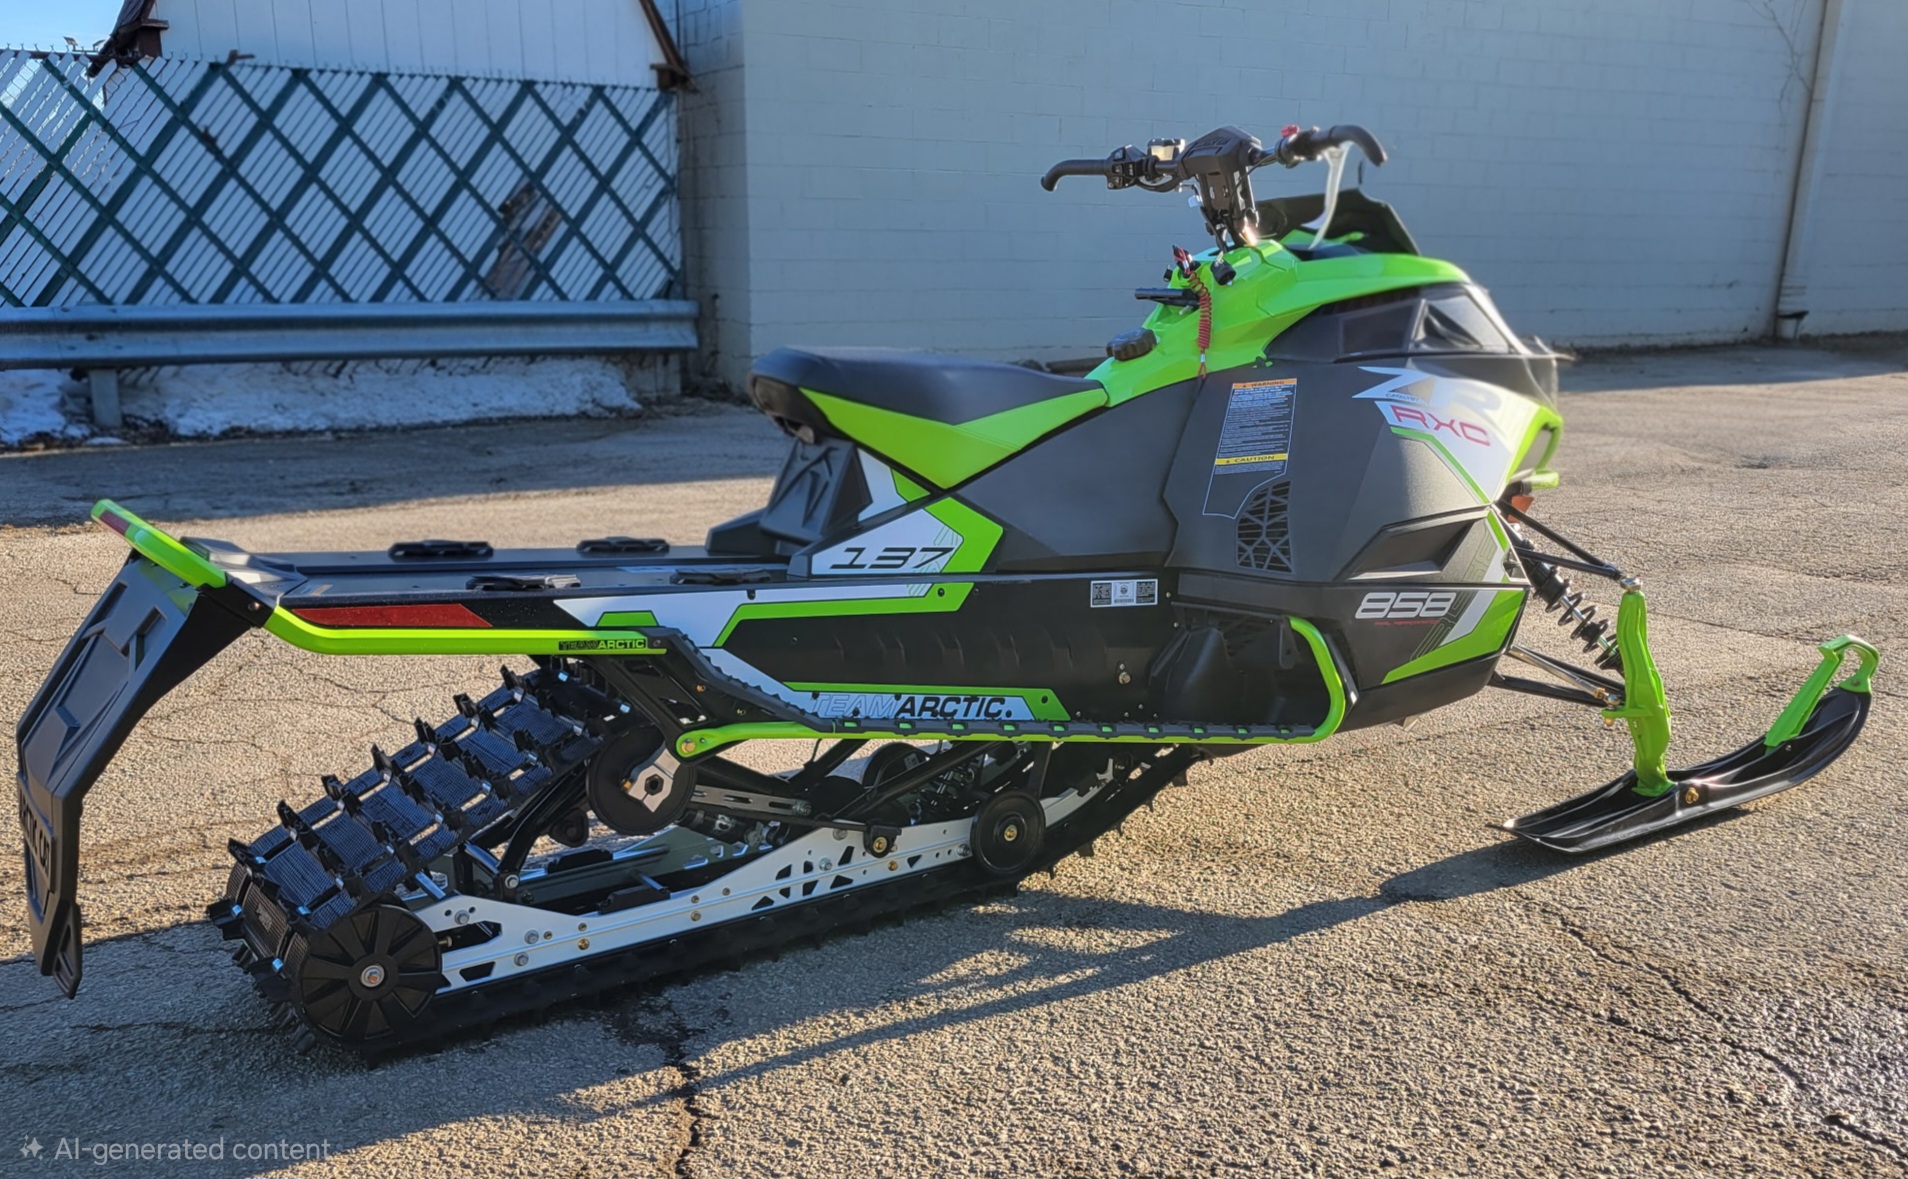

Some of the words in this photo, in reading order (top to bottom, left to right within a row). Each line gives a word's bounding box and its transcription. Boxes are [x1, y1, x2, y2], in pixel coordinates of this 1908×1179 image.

[1251, 380, 1285, 388] WARNING
[1389, 404, 1491, 447] RXC
[1234, 455, 1275, 463] CAUTION
[829, 547, 954, 569] 137
[1355, 592, 1457, 619] 858
